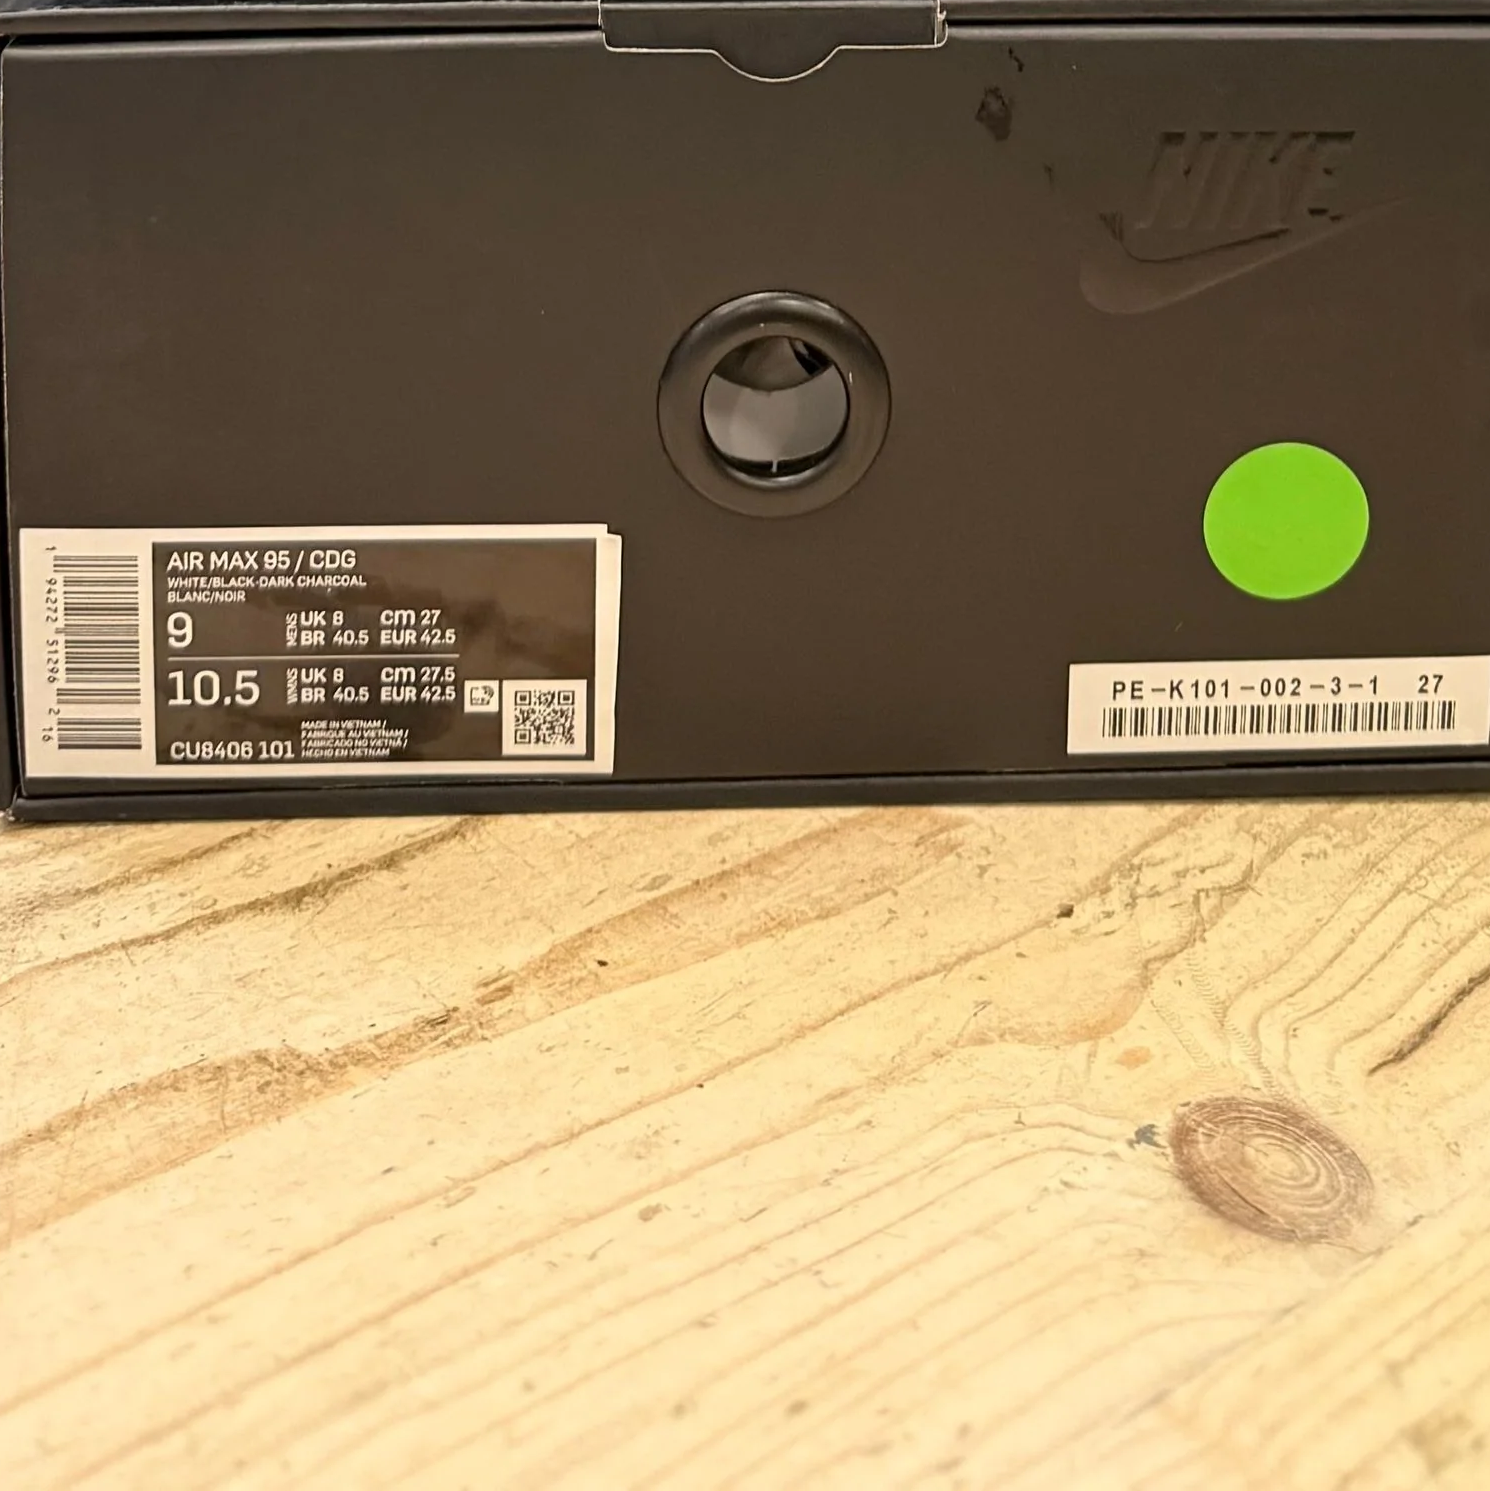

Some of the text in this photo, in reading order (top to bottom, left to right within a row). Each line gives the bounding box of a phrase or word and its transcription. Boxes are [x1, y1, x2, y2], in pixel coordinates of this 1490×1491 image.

[1134, 130, 1357, 231] NIKE
[166, 549, 357, 574] AIR MAX 95 / CDG
[297, 574, 367, 587] CHARCOAL
[167, 590, 247, 603] BLANC/NOIR
[300, 610, 327, 627] UK
[332, 610, 344, 626] 8
[420, 609, 442, 626] 27
[166, 611, 194, 648] 9
[300, 628, 457, 646] BR 40.5 EUR 42.5
[300, 667, 327, 684] UK
[332, 667, 344, 683] 8
[420, 666, 456, 683] 27.5
[167, 669, 261, 707] 10.5
[300, 685, 457, 704] BR 40.5 EUR 42.5
[1418, 674, 1445, 696] 27
[301, 720, 328, 730] MADE
[170, 740, 295, 760] CU8406 101
